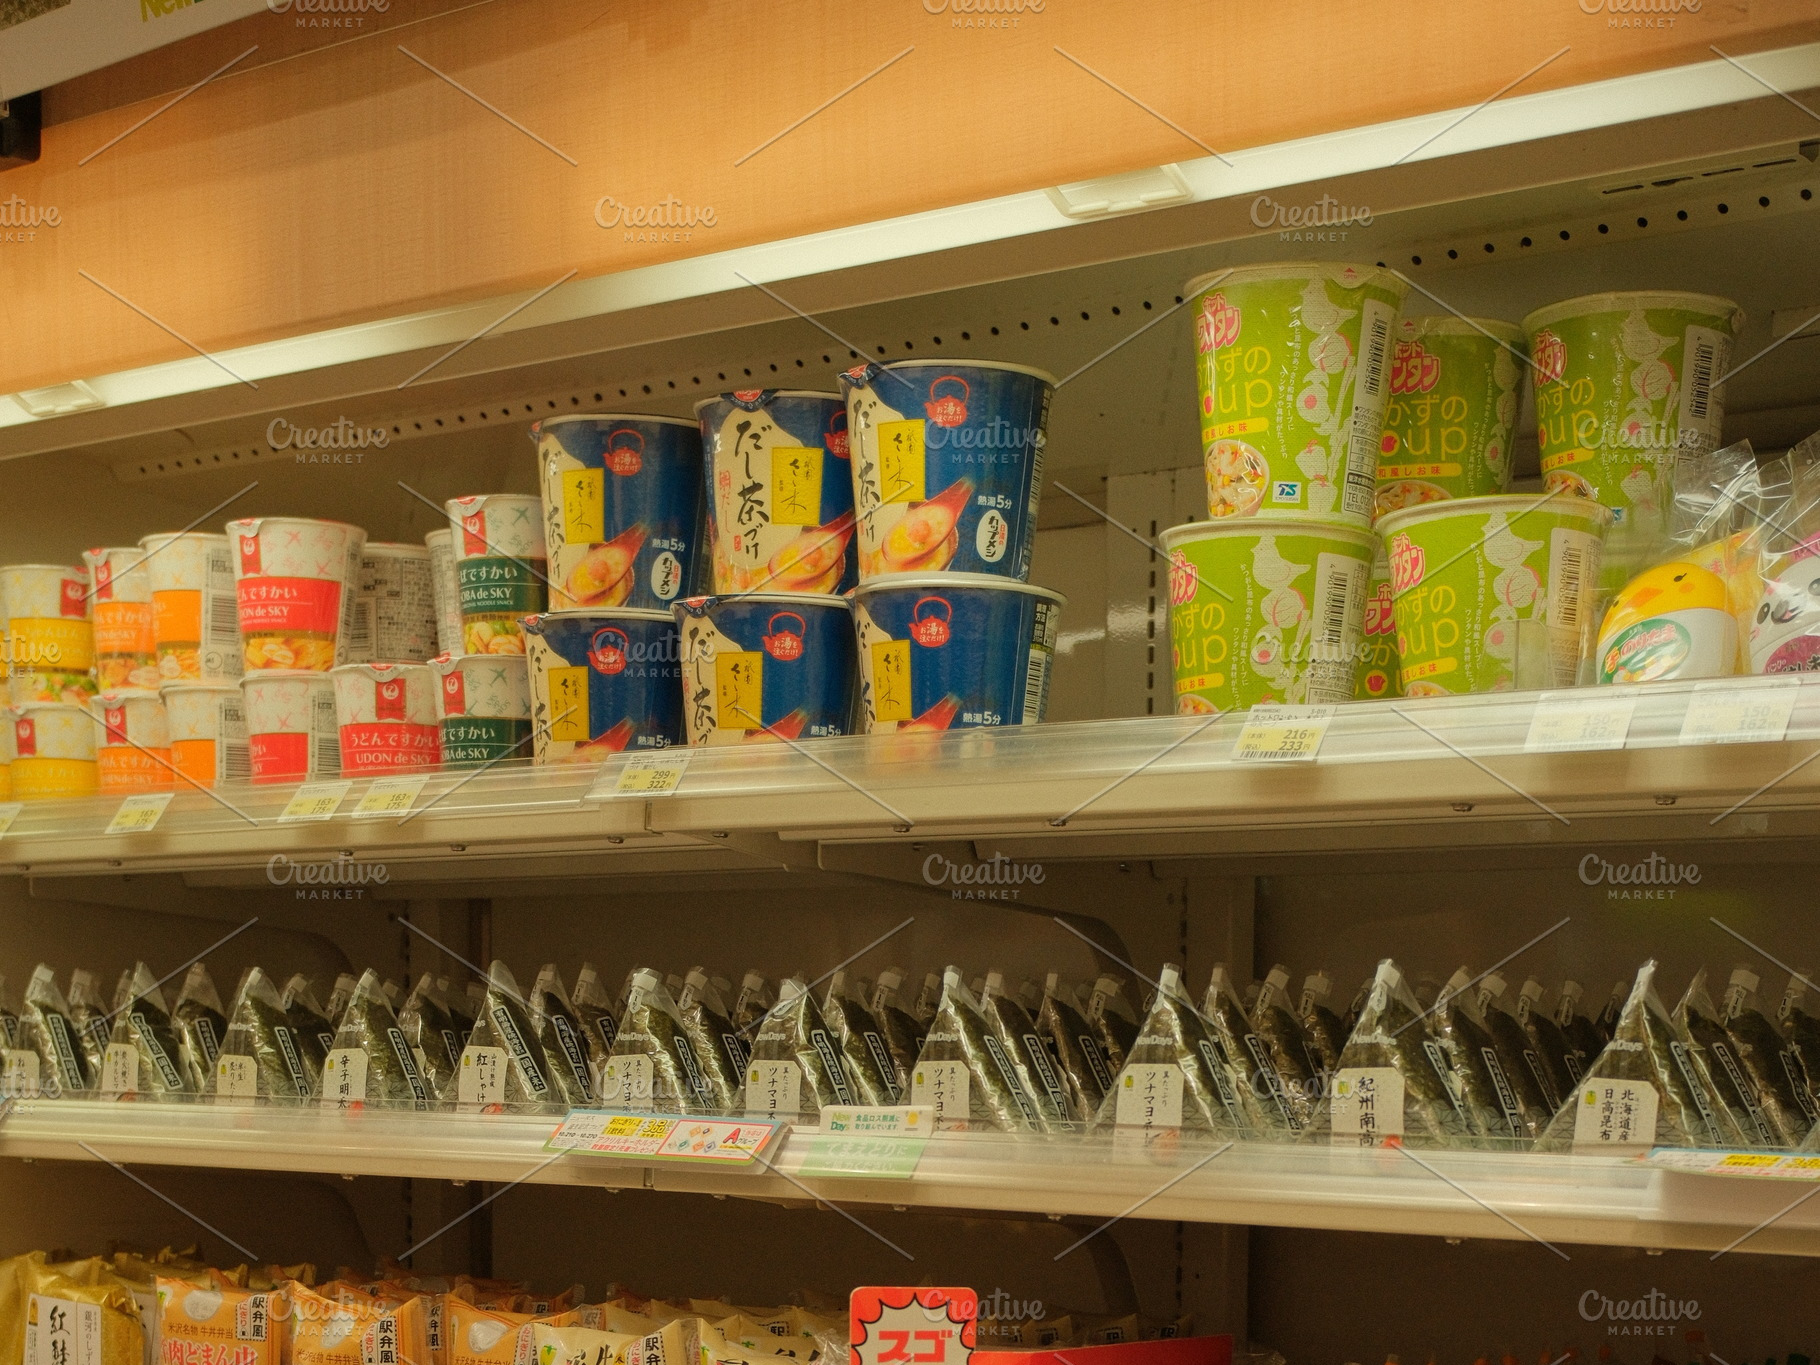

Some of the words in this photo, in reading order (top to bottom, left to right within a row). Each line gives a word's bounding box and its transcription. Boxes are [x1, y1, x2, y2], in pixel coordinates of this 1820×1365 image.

[734, 420, 772, 560] だし茶づけ
[977, 494, 1013, 510] 熱湯5分
[985, 515, 999, 558] カップメシ
[477, 588, 489, 600] de
[490, 587, 512, 599] SKY
[962, 711, 1002, 725] 熱湯5分
[356, 752, 393, 764] UDON
[394, 751, 407, 763] de
[410, 750, 432, 764] SKY
[468, 747, 489, 759] SKY
[651, 770, 671, 780] 299
[617, 1032, 650, 1042] NewDays
[1135, 1035, 1173, 1046] NewDays
[337, 1054, 351, 1110] 辛子明太
[475, 1052, 490, 1103] 紅しゃけ
[1601, 1088, 1615, 1142] 日高昆布
[1619, 1089, 1636, 1142] 北海道産
[723, 1127, 741, 1144] A
[251, 1295, 265, 1339] 駅弁風
[167, 1323, 199, 1338] 米沢名物
[199, 1326, 234, 1340] 牛丼弁当
[378, 1318, 396, 1365] 駅弁風
[877, 1329, 954, 1363] スゴ
